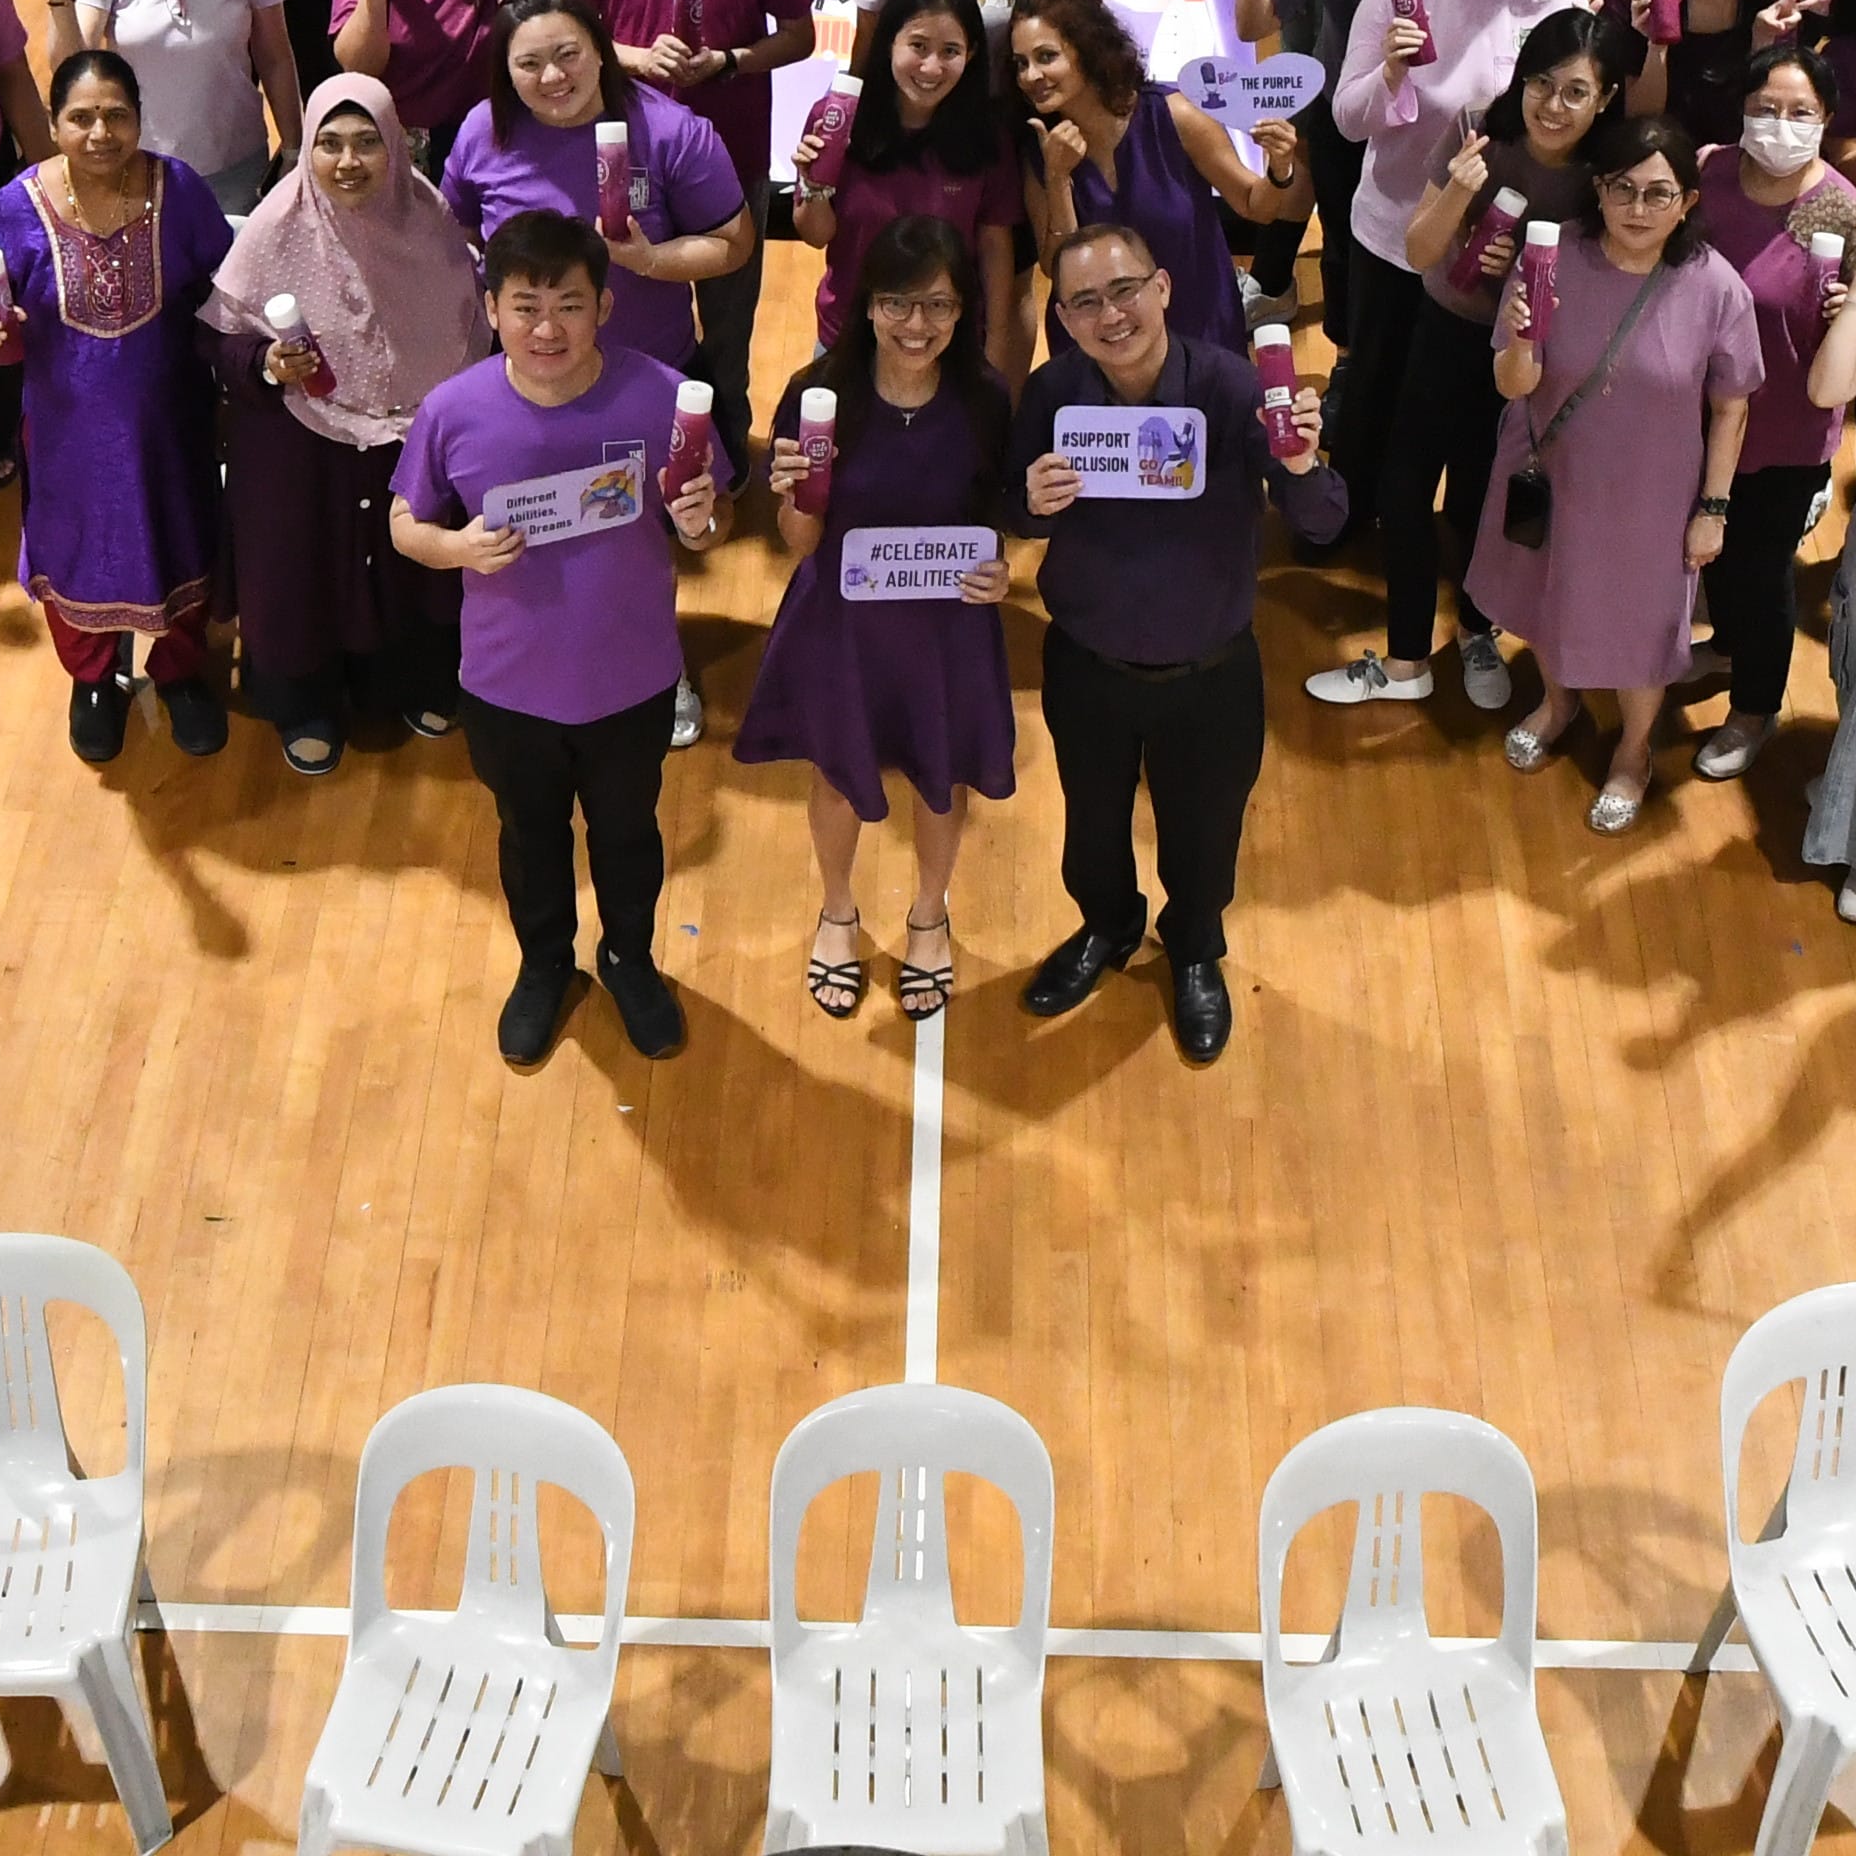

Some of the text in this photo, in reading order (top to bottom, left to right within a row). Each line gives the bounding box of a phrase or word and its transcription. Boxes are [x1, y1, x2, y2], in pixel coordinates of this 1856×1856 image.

[1240, 77, 1260, 91] THE
[1262, 75, 1304, 90] PURPLE
[1253, 95, 1296, 109] PARADE
[1061, 431, 1131, 449] #SUPPORT
[1138, 459, 1159, 471] GO
[506, 490, 557, 510] Different
[508, 506, 557, 525] Abilities,
[529, 519, 573, 536] Dreams
[870, 542, 979, 562] #CELEBRATE
[885, 569, 964, 589] ABILITIES
